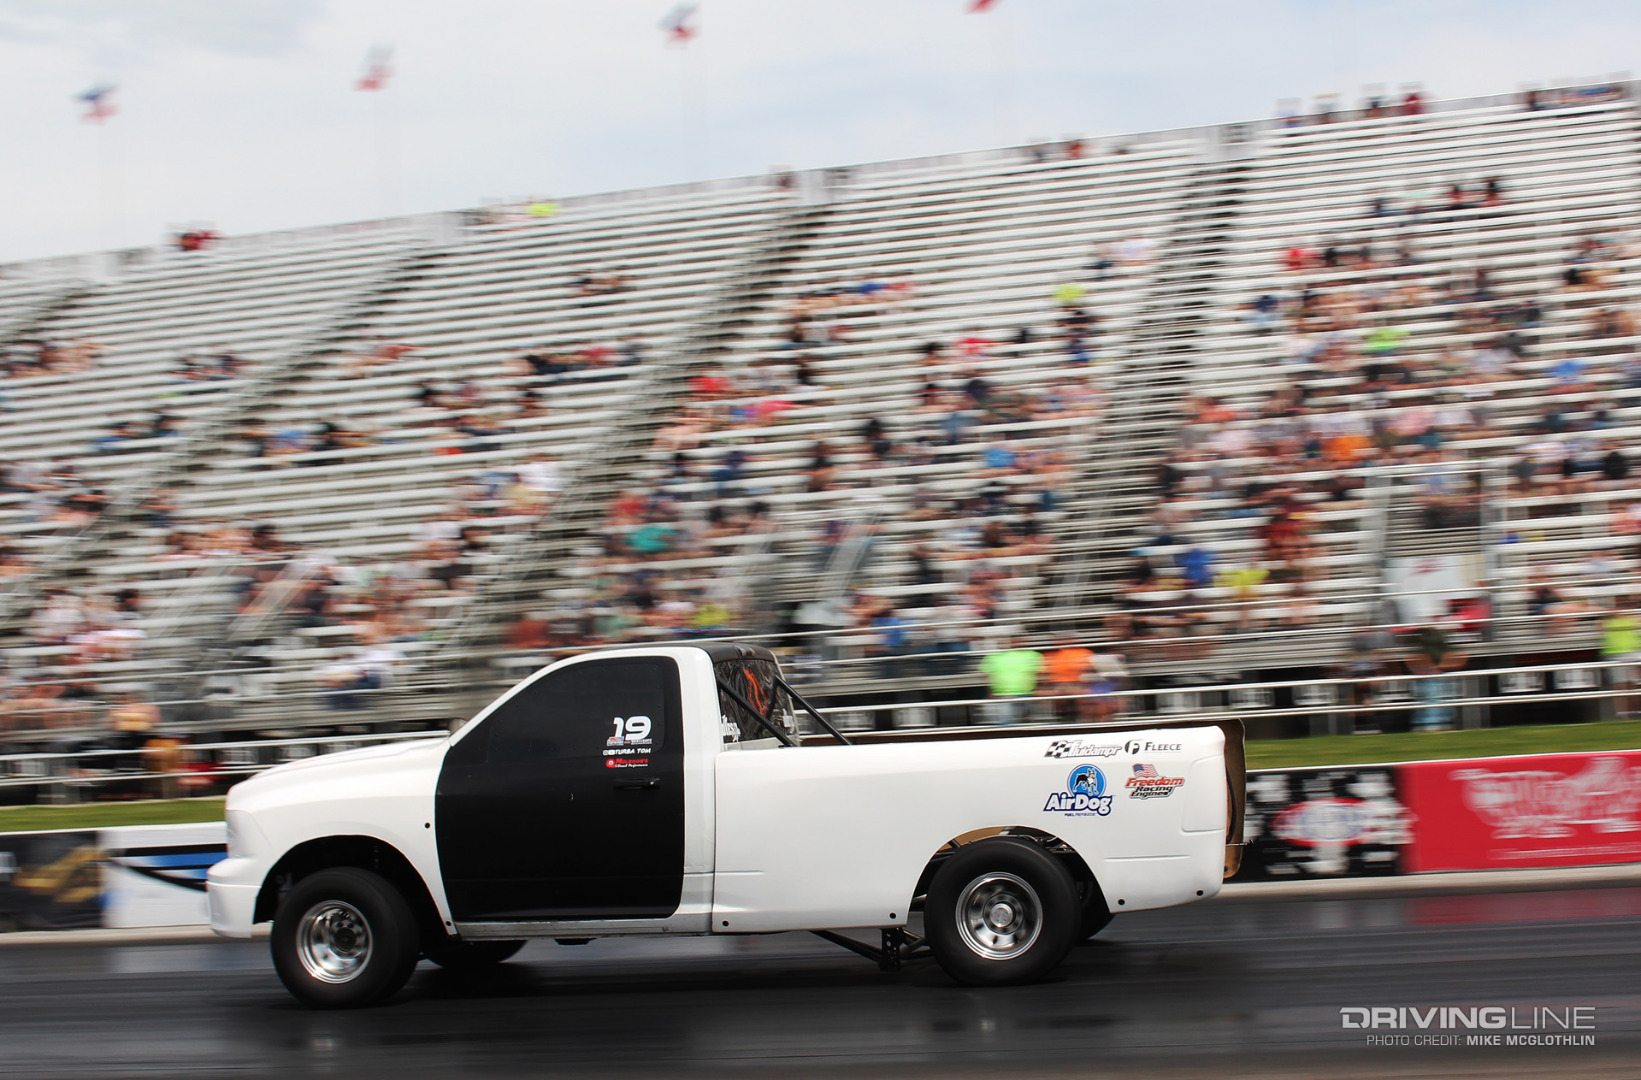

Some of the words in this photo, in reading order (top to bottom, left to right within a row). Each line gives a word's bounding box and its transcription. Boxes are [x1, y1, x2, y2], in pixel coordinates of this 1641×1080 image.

[613, 716, 651, 740] 19
[1125, 777, 1184, 787] Freedom
[1043, 792, 1113, 816] AirDog
